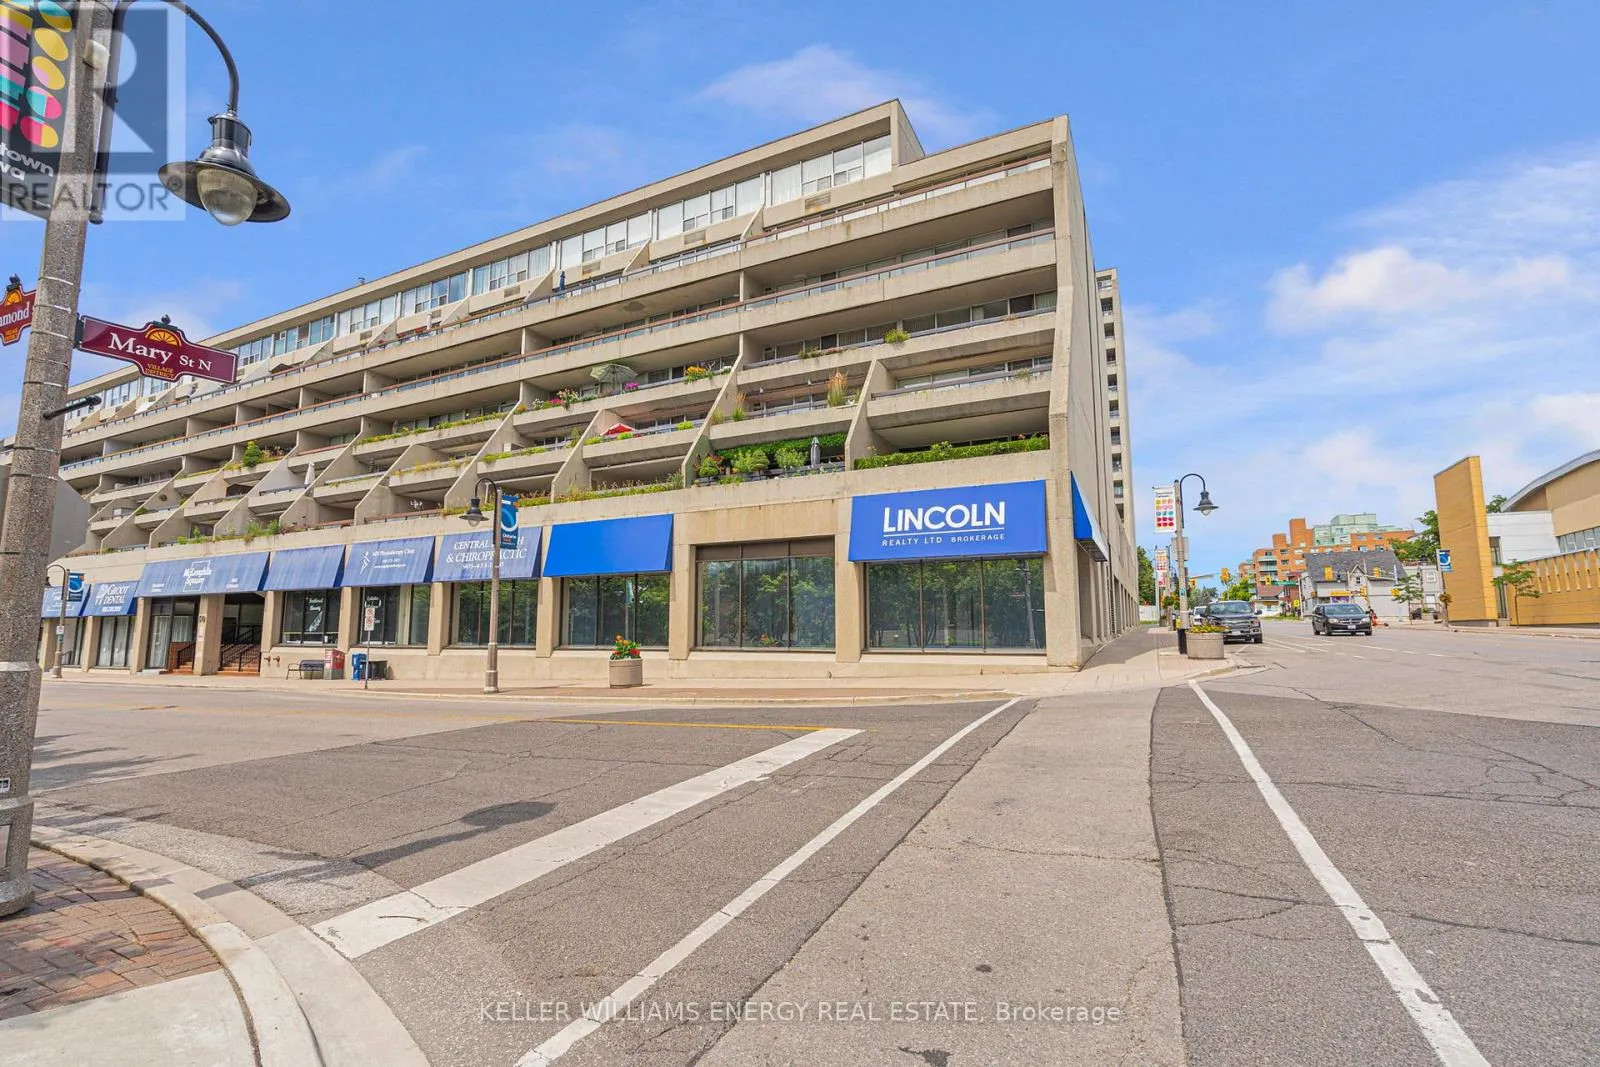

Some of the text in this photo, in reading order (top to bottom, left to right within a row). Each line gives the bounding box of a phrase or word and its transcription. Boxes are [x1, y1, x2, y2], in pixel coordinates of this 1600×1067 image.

[108, 332, 212, 371] Mary St N
[145, 368, 175, 379] DISTRICT
[147, 363, 174, 373] VILLAGE
[883, 501, 1005, 533] LINCOLN
[454, 540, 490, 550] CENTRAL
[882, 533, 1005, 546] REALTY LTD BROKERAGE
[446, 548, 527, 563] & CHIROPACTIC
[103, 594, 126, 605] DENTAL
